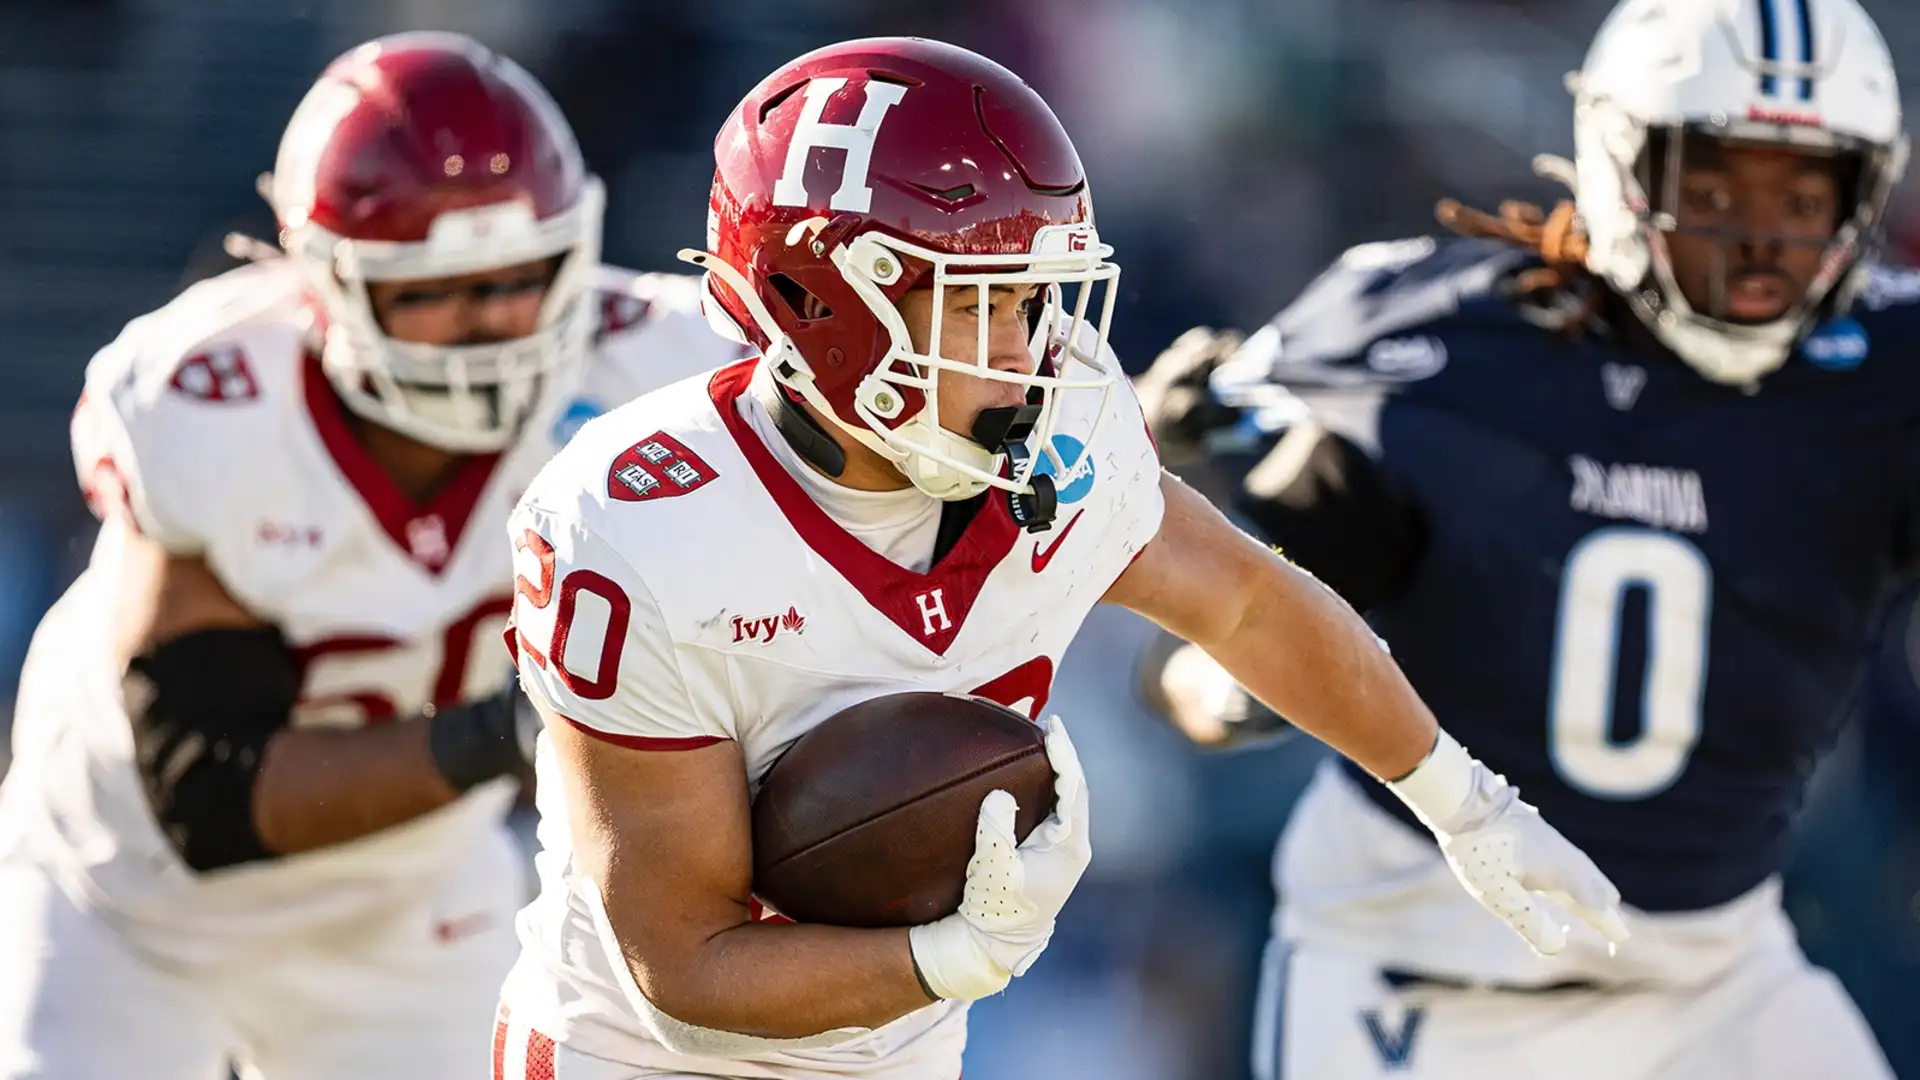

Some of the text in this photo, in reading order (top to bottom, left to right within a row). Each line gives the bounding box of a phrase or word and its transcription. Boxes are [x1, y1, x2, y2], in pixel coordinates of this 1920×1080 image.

[773, 77, 908, 213] H
[516, 528, 632, 700] 20
[732, 615, 779, 643] Ivy
[915, 588, 952, 637] H
[1548, 527, 1712, 799] 0
[1358, 1004, 1428, 1069] V
